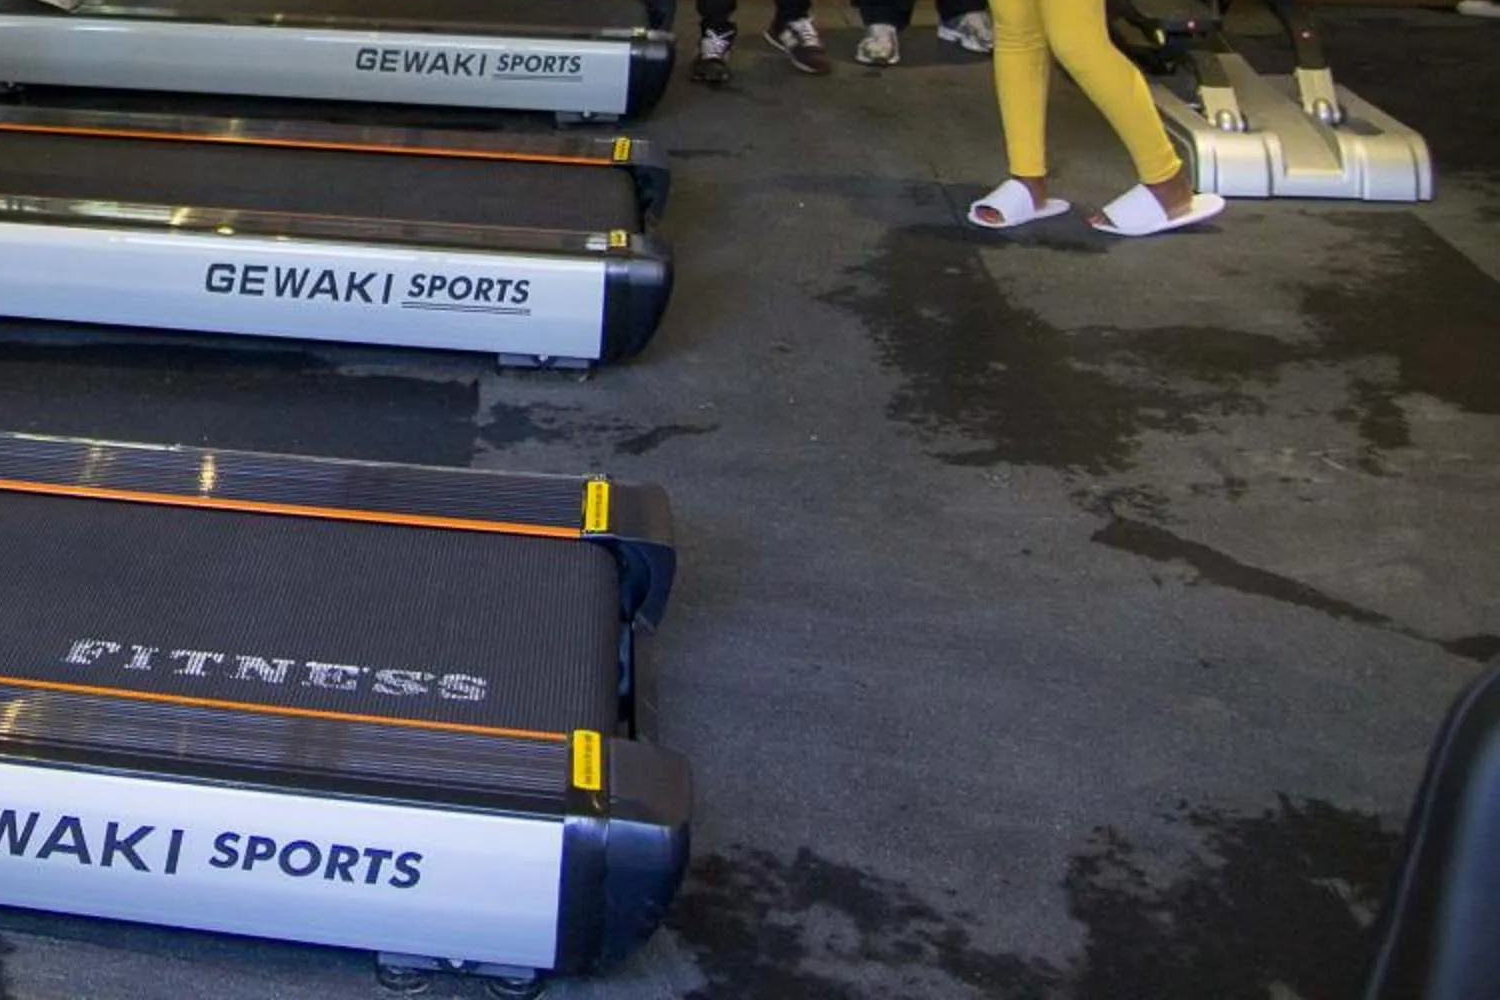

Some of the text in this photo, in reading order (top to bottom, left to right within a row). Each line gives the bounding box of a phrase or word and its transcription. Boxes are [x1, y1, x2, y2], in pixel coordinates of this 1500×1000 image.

[355, 47, 582, 77] GEWAKI SPORTS
[204, 262, 532, 305] GEWAKI SPORTS
[62, 637, 489, 702] FITNESS
[207, 830, 424, 889] SPORTS
